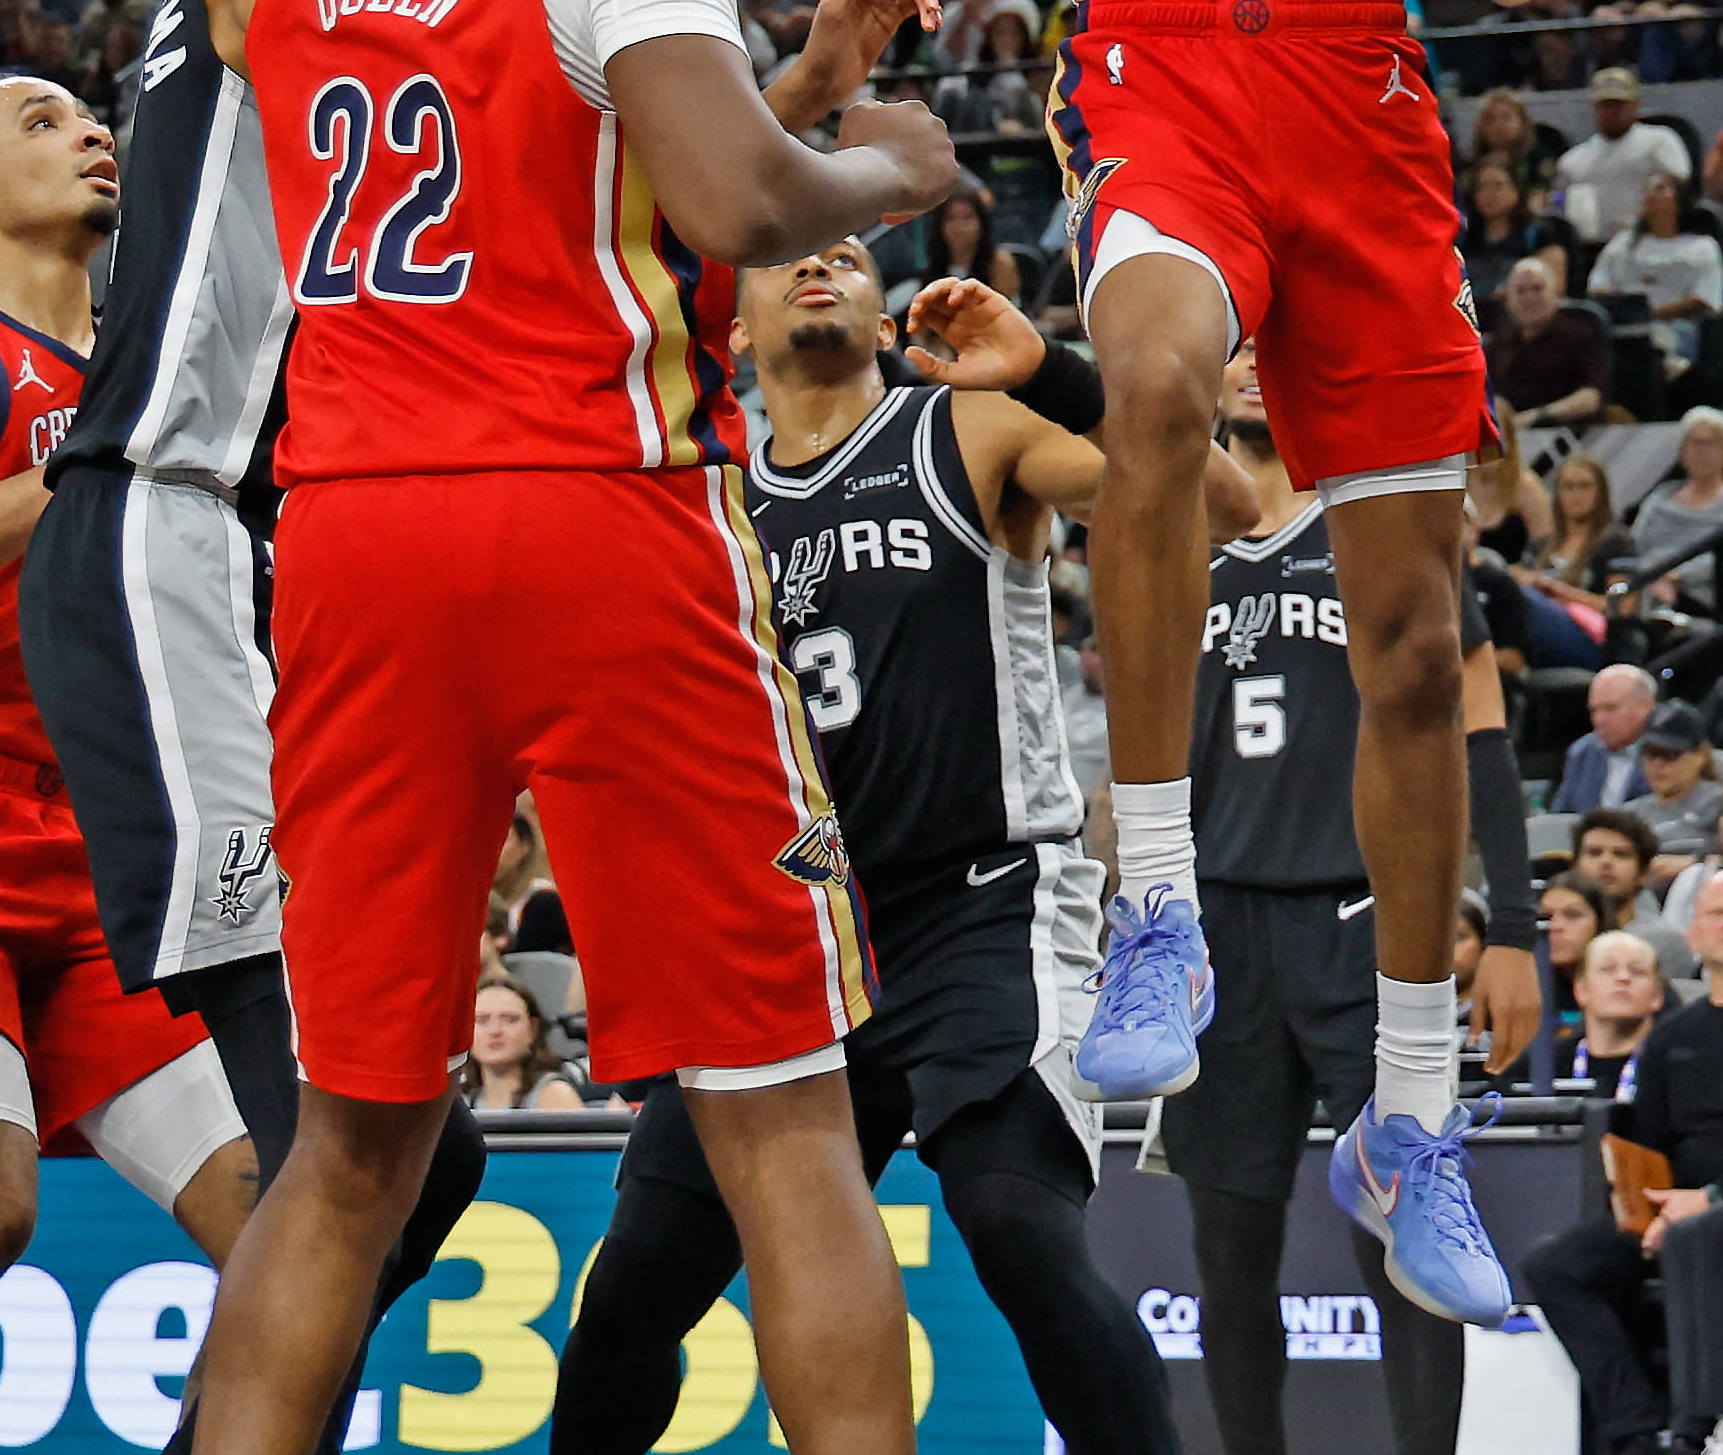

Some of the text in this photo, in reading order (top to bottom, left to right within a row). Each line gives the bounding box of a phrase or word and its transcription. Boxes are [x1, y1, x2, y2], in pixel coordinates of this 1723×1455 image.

[294, 73, 475, 306] 22
[788, 625, 862, 734] 3
[1231, 673, 1287, 760] 5
